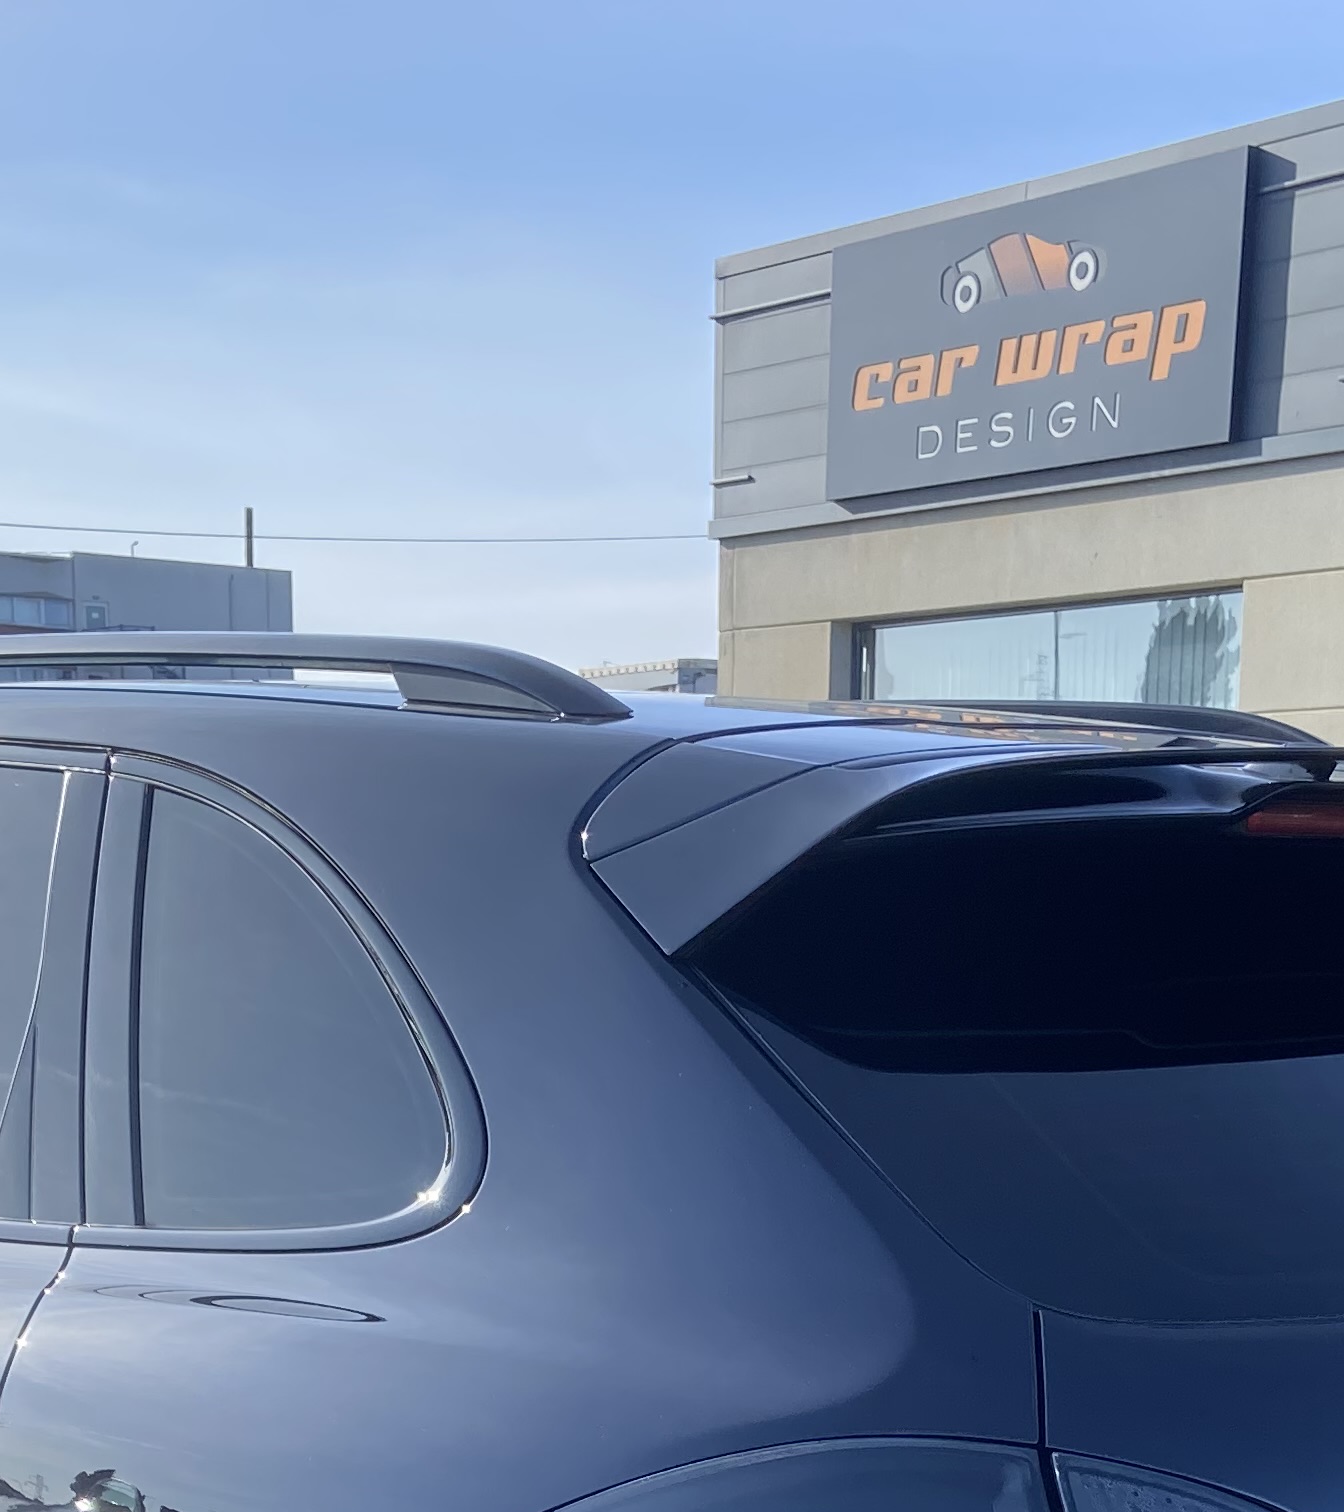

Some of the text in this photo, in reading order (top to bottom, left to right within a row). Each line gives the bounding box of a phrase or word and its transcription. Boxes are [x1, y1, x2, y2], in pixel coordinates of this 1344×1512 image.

[852, 298, 1207, 412] car wrap
[916, 392, 1121, 460] DESIGN
